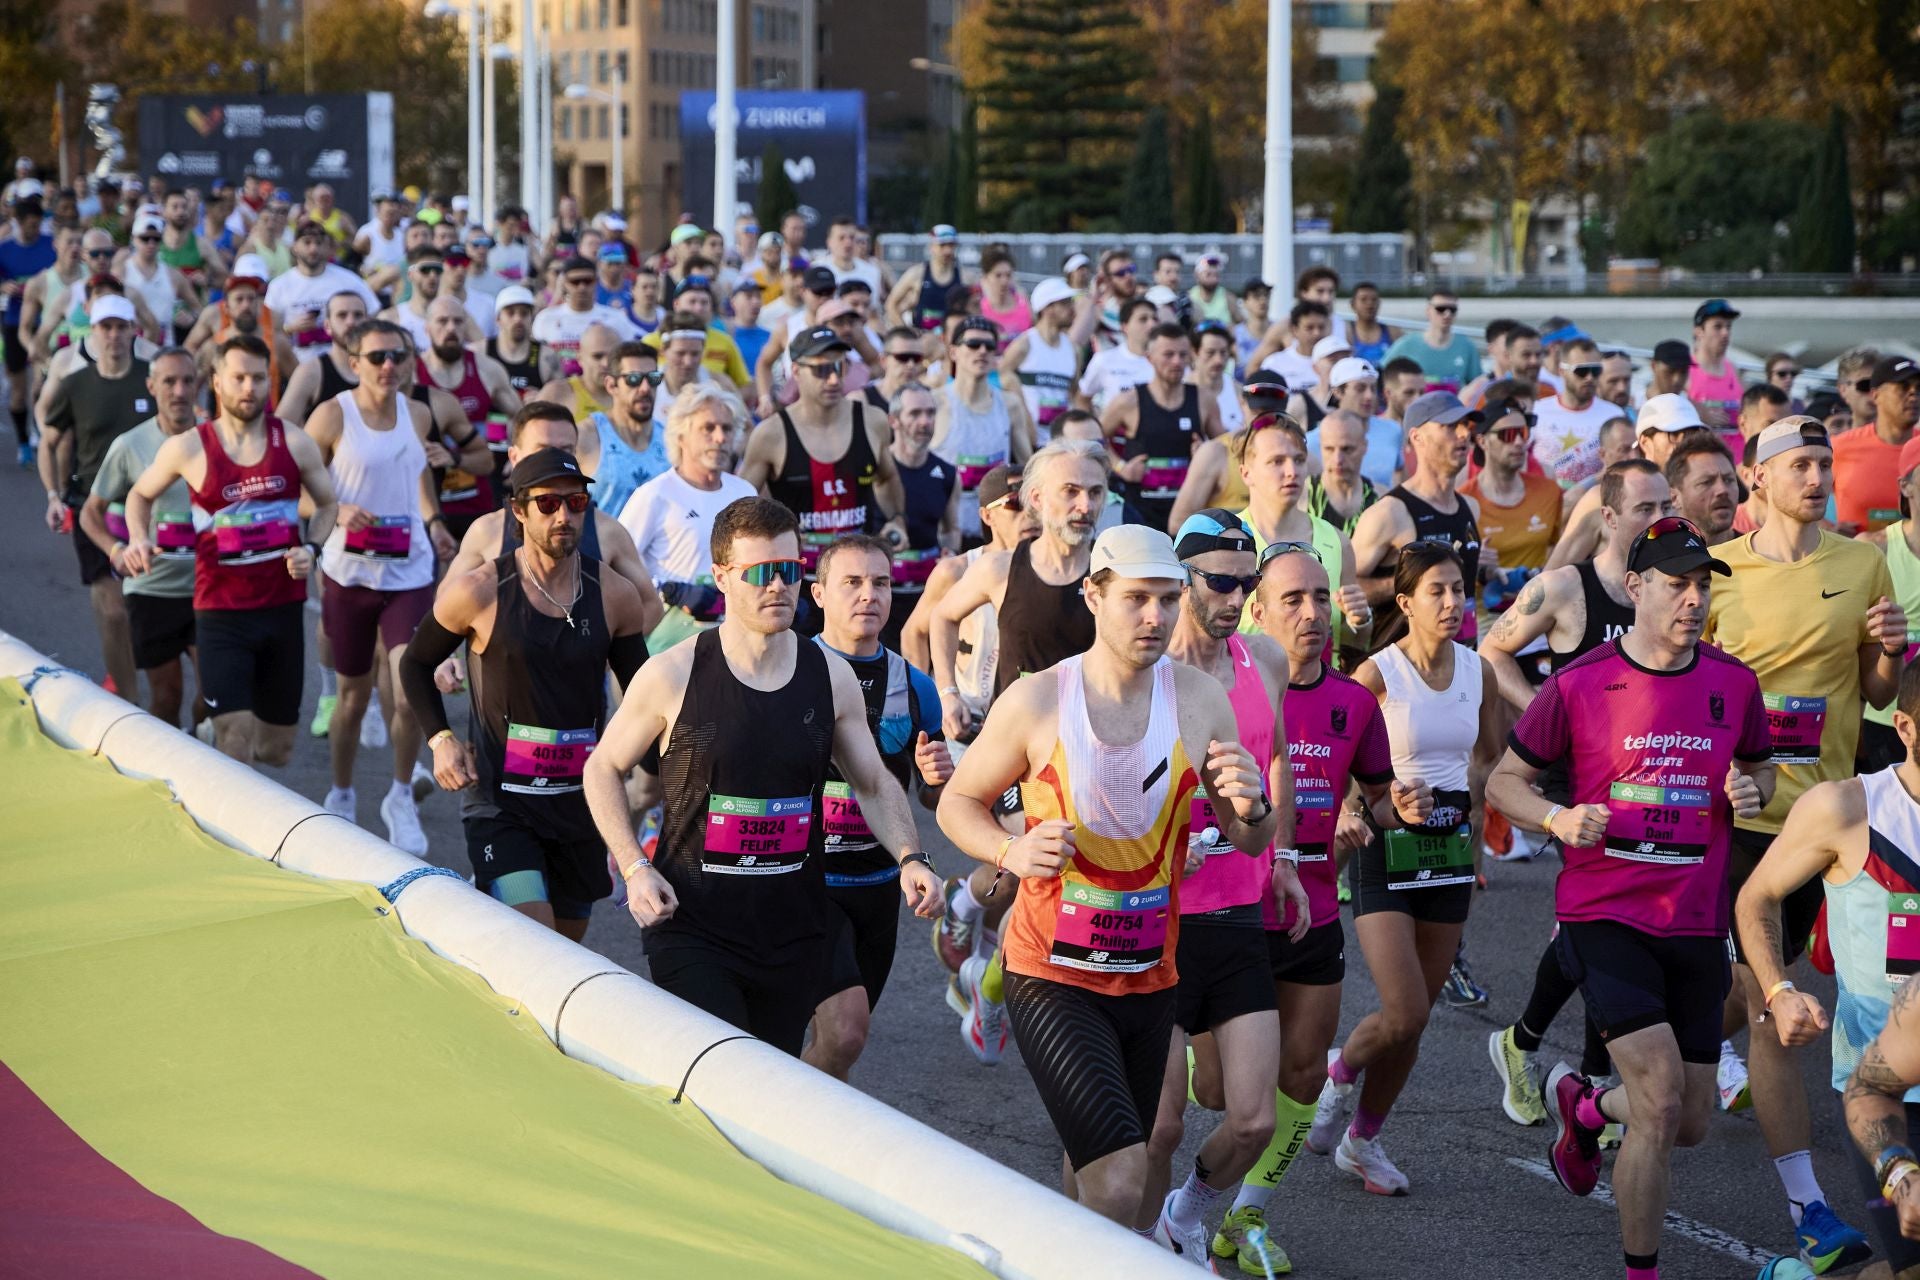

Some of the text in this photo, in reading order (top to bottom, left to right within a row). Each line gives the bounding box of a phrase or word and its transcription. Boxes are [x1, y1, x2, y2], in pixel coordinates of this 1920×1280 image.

[746, 107, 826, 129] ZURICH
[1288, 740, 1331, 758] pizza
[1623, 731, 1712, 754] telepizza
[532, 746, 573, 760] 40135
[1642, 757, 1684, 767] ALGETE
[1668, 774, 1708, 786] ANFIOS
[1643, 808, 1680, 824] 7219
[739, 820, 785, 835] 33824
[1646, 827, 1673, 839] Dani
[740, 840, 781, 851] FELIPE
[1416, 839, 1447, 852] 1914
[1141, 895, 1162, 903] ZURICH
[1090, 913, 1143, 931] 40754
[1090, 933, 1139, 950] Philipp
